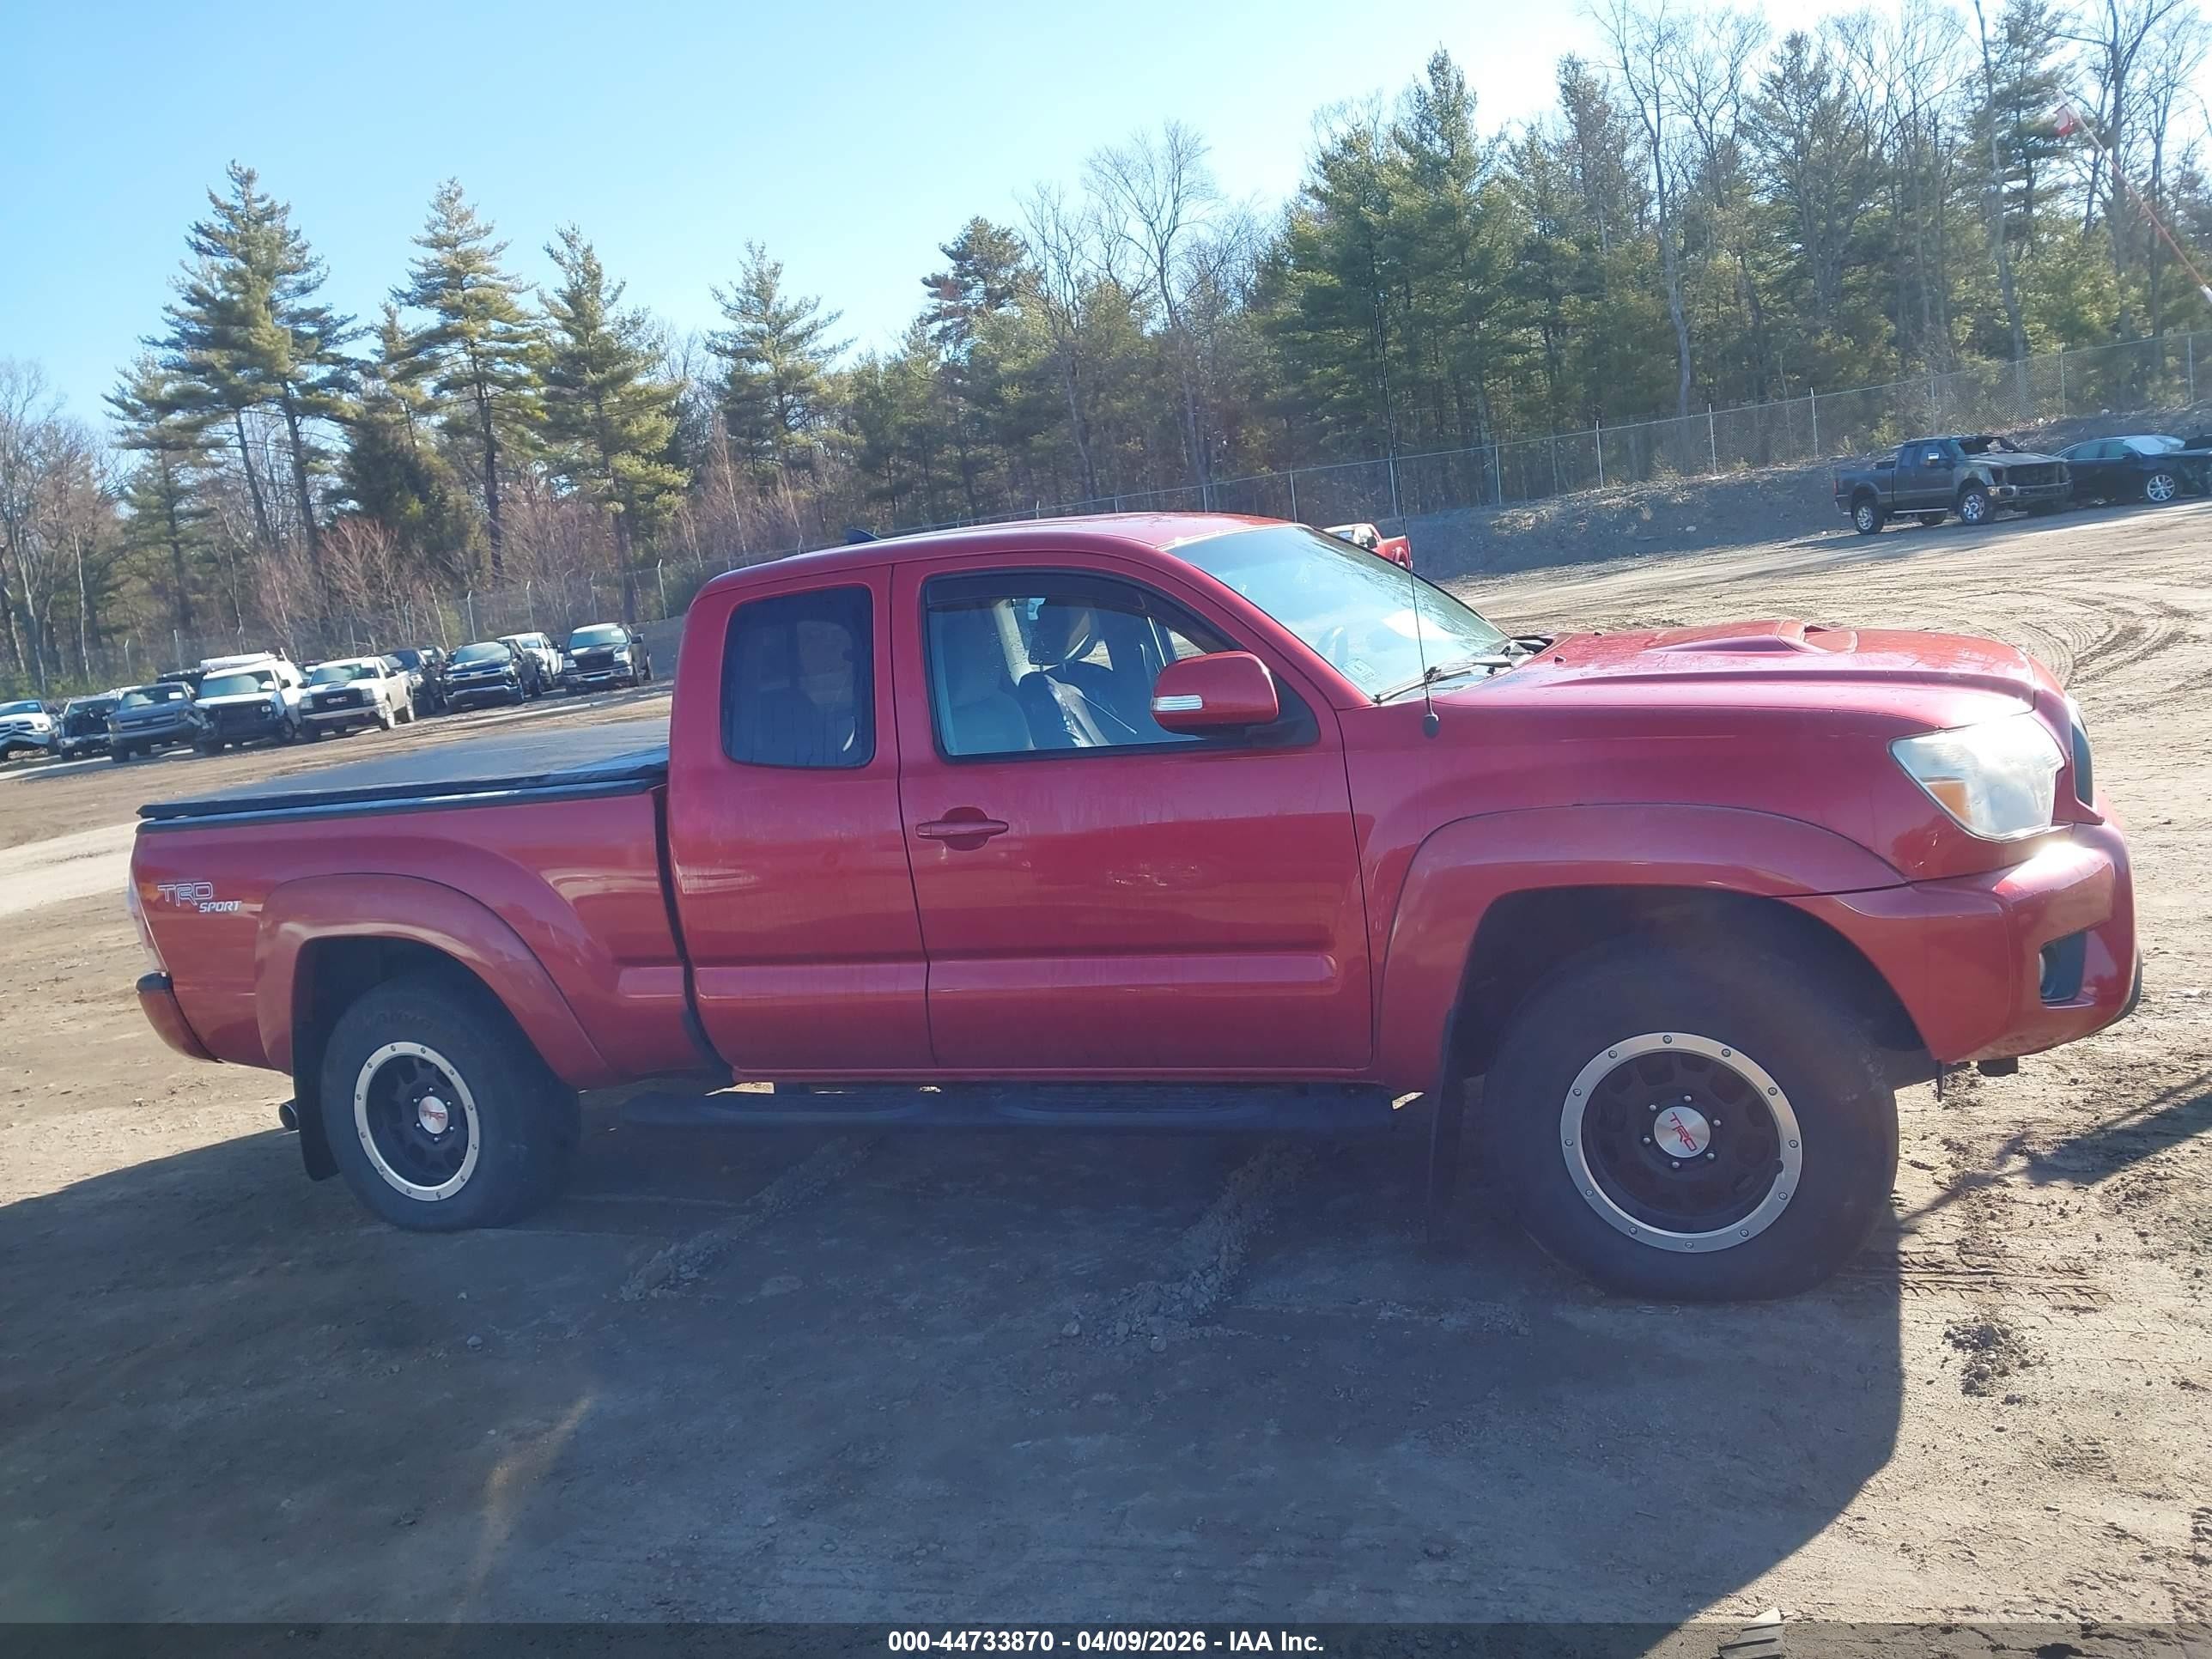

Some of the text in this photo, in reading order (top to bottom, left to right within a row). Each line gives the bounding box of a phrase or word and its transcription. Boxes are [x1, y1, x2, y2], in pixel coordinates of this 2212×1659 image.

[157, 881, 214, 907] TRD
[198, 900, 242, 913] SPORT
[1668, 1111, 1698, 1152] TRD
